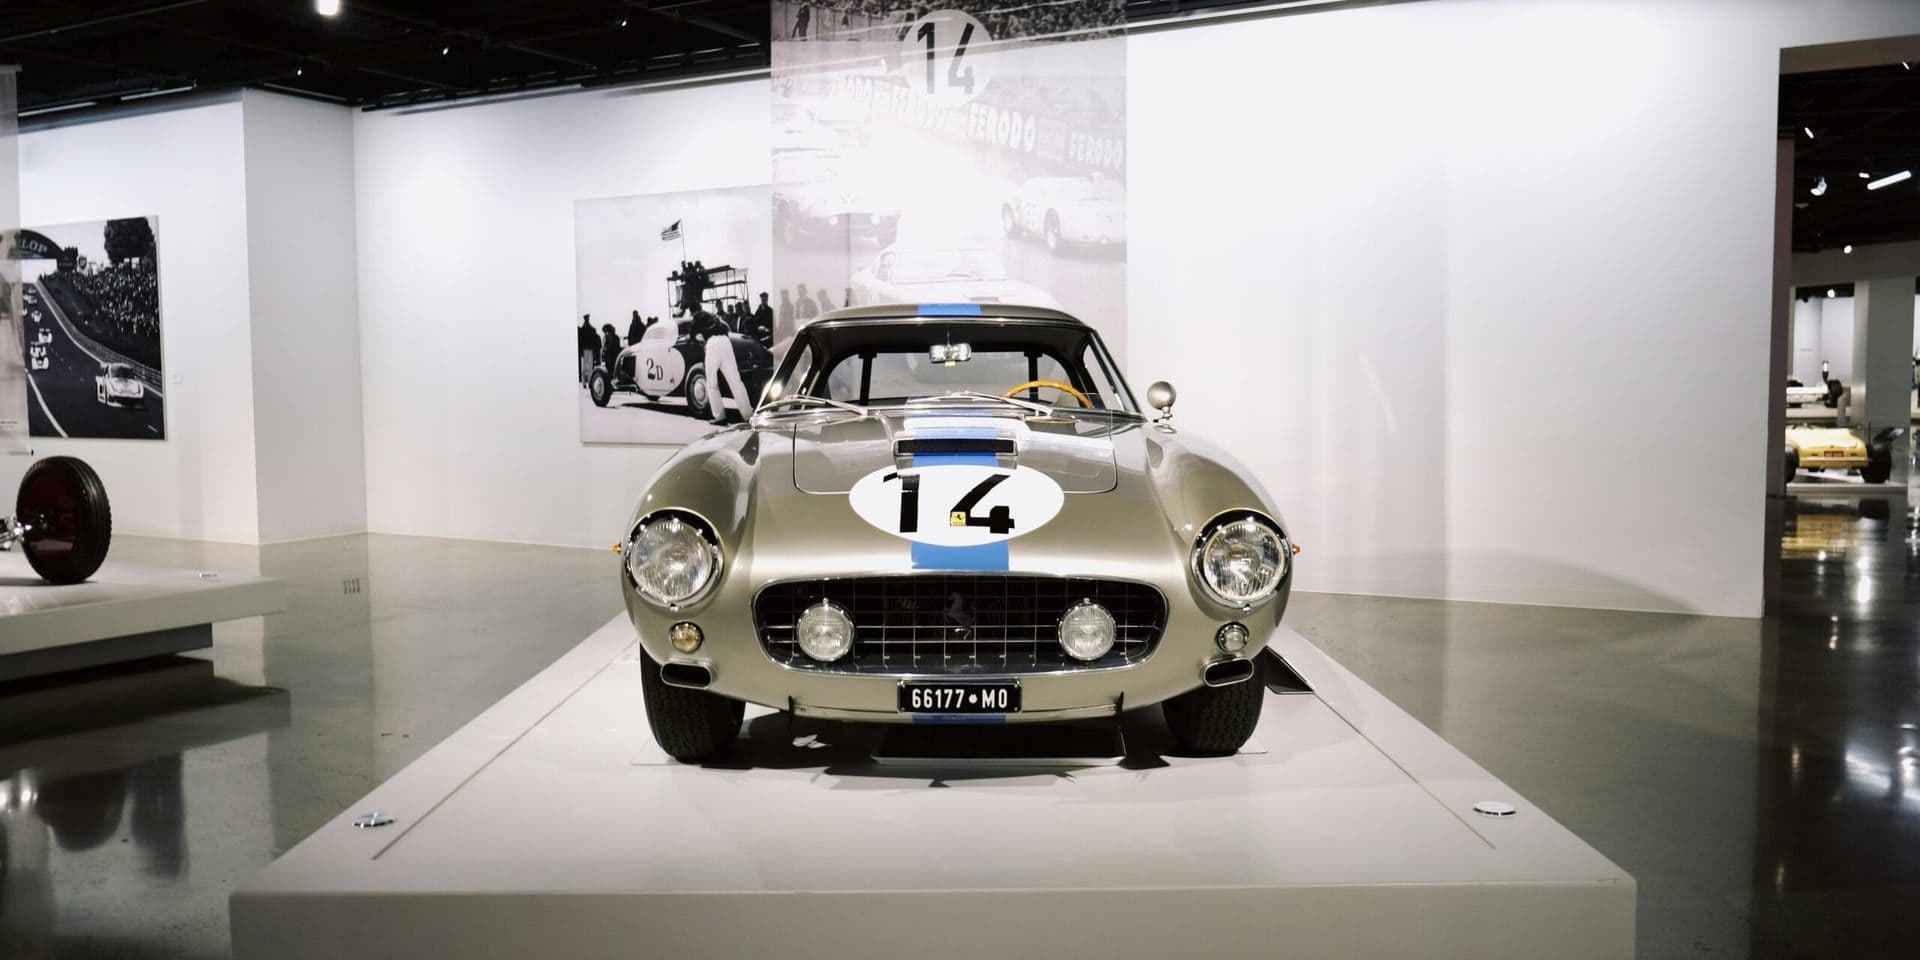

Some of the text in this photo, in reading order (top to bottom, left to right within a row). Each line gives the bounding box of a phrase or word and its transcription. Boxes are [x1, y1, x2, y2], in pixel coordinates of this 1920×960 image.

[917, 22, 975, 95] 14
[968, 102, 1037, 152] FERODO
[1070, 131, 1123, 169] FERODO
[646, 357, 664, 381] 2D
[883, 472, 1015, 534] 14
[912, 689, 965, 708] 66177
